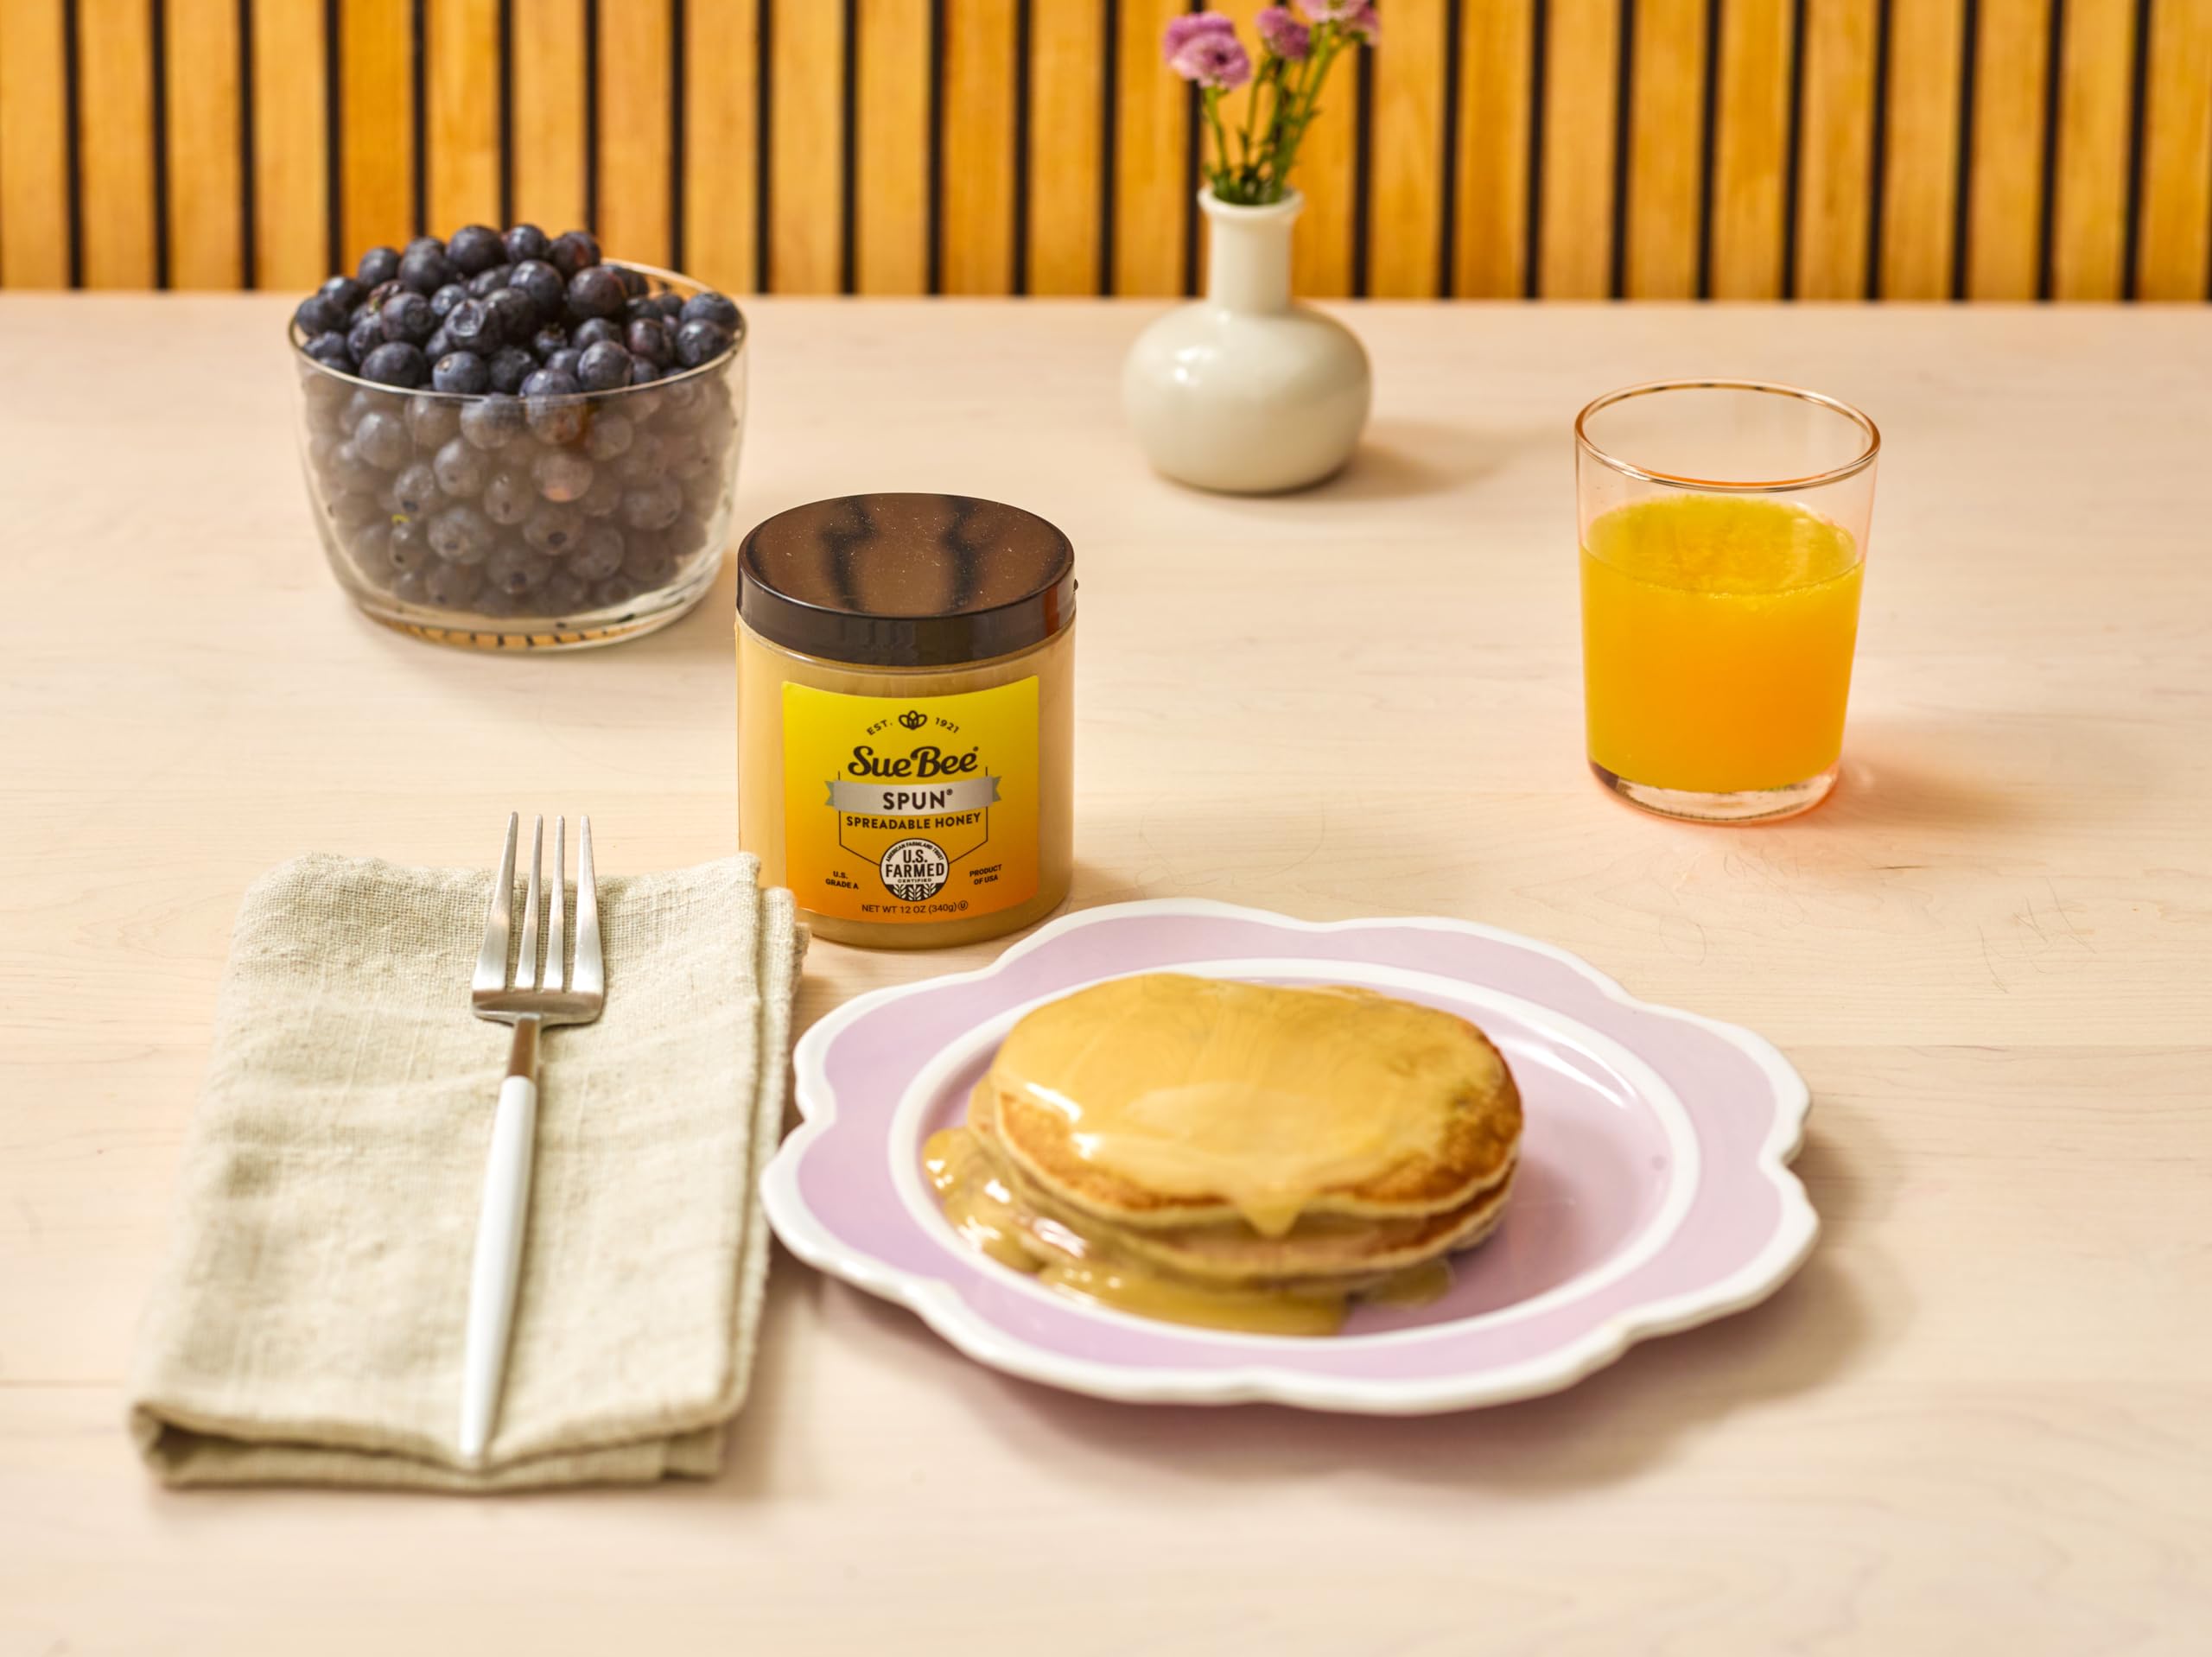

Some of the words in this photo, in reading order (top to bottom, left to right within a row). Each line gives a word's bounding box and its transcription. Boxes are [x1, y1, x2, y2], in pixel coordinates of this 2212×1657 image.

[866, 719, 893, 736] EST.
[935, 717, 960, 733] 1921
[846, 816, 931, 829] SPREADABLE
[935, 812, 982, 828] HONEY
[886, 843, 906, 862] AMERICAN
[932, 847, 944, 860] TRUST
[903, 849, 928, 863] U.S.
[833, 870, 849, 879] U.S.
[886, 862, 944, 878] FARMED
[969, 863, 1002, 877] PRODUCT
[825, 878, 852, 889] GRADE
[974, 877, 983, 886] OF
[984, 873, 998, 883] USA
[861, 904, 880, 913] NET
[882, 905, 897, 913] WT
[900, 905, 911, 914] 12
[912, 905, 926, 914] OZ
[928, 902, 957, 914] (340g)
